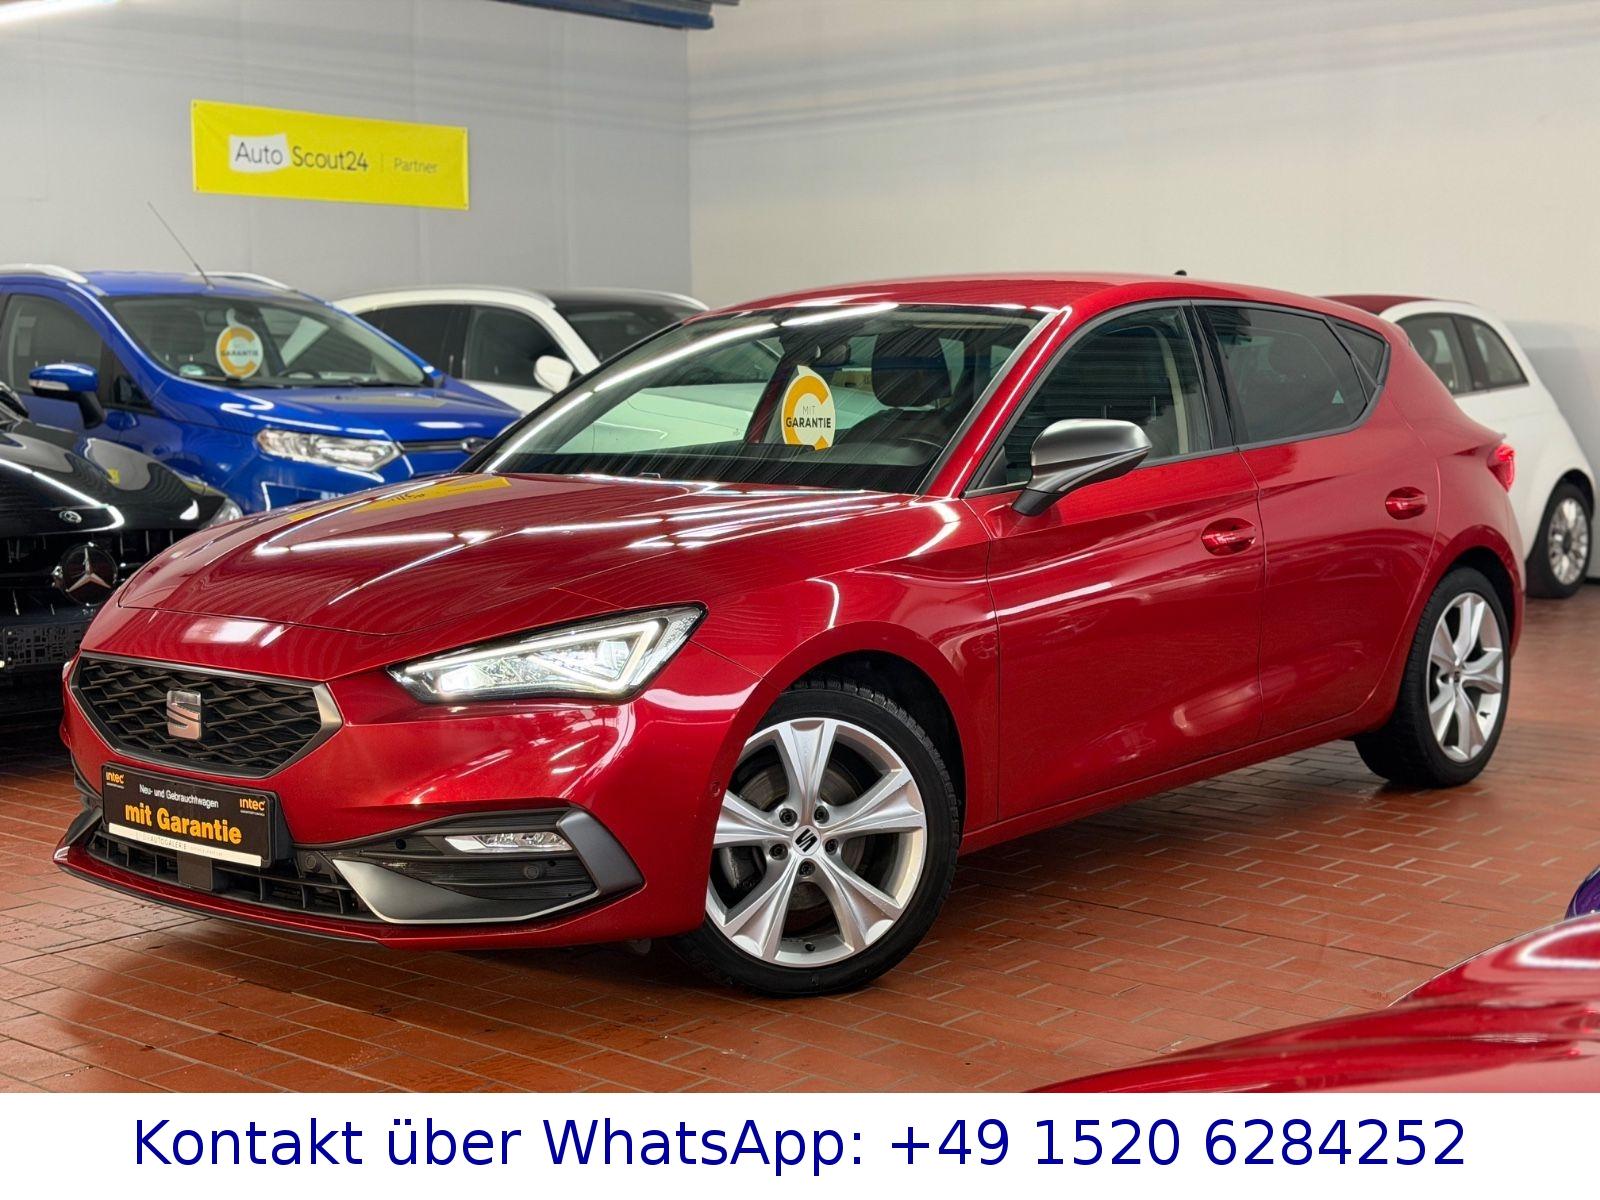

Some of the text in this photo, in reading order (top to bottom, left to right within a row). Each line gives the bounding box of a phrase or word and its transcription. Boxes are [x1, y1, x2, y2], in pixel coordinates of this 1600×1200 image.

[234, 141, 438, 174] Auto Scout24 Partner
[785, 417, 832, 429] GARANTIE
[802, 405, 816, 416] MIT
[139, 783, 153, 796] Neu-
[153, 788, 165, 799] und
[165, 789, 219, 809] Gebrauchtwagen
[125, 802, 243, 845] mit Garantie
